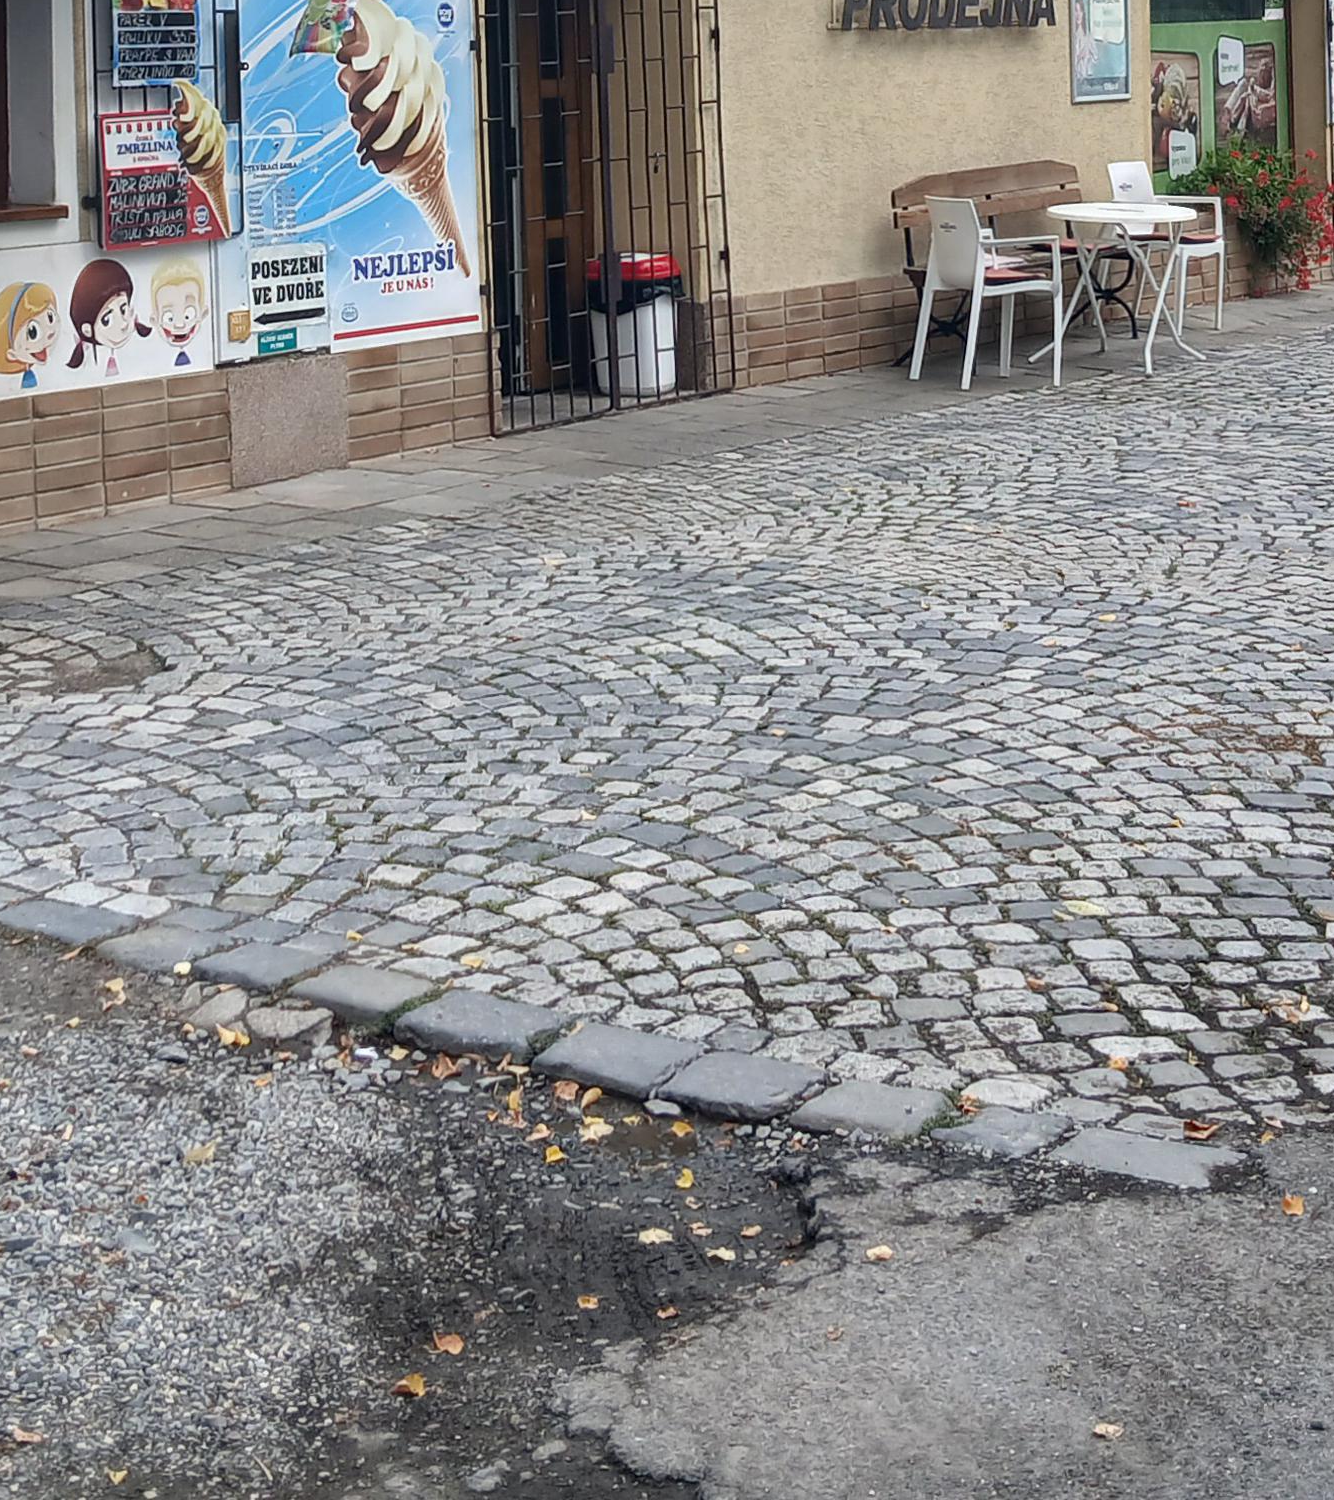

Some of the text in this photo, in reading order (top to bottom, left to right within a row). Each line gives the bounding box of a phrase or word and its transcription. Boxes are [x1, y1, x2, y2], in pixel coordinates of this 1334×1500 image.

[116, 141, 173, 155] ZMRZLINA
[251, 251, 325, 280] POSEZENÍ
[353, 243, 455, 281] NEJLEPŠÍ
[252, 277, 325, 305] VE DVOŘE
[381, 282, 394, 294] JE
[396, 281, 405, 291] U
